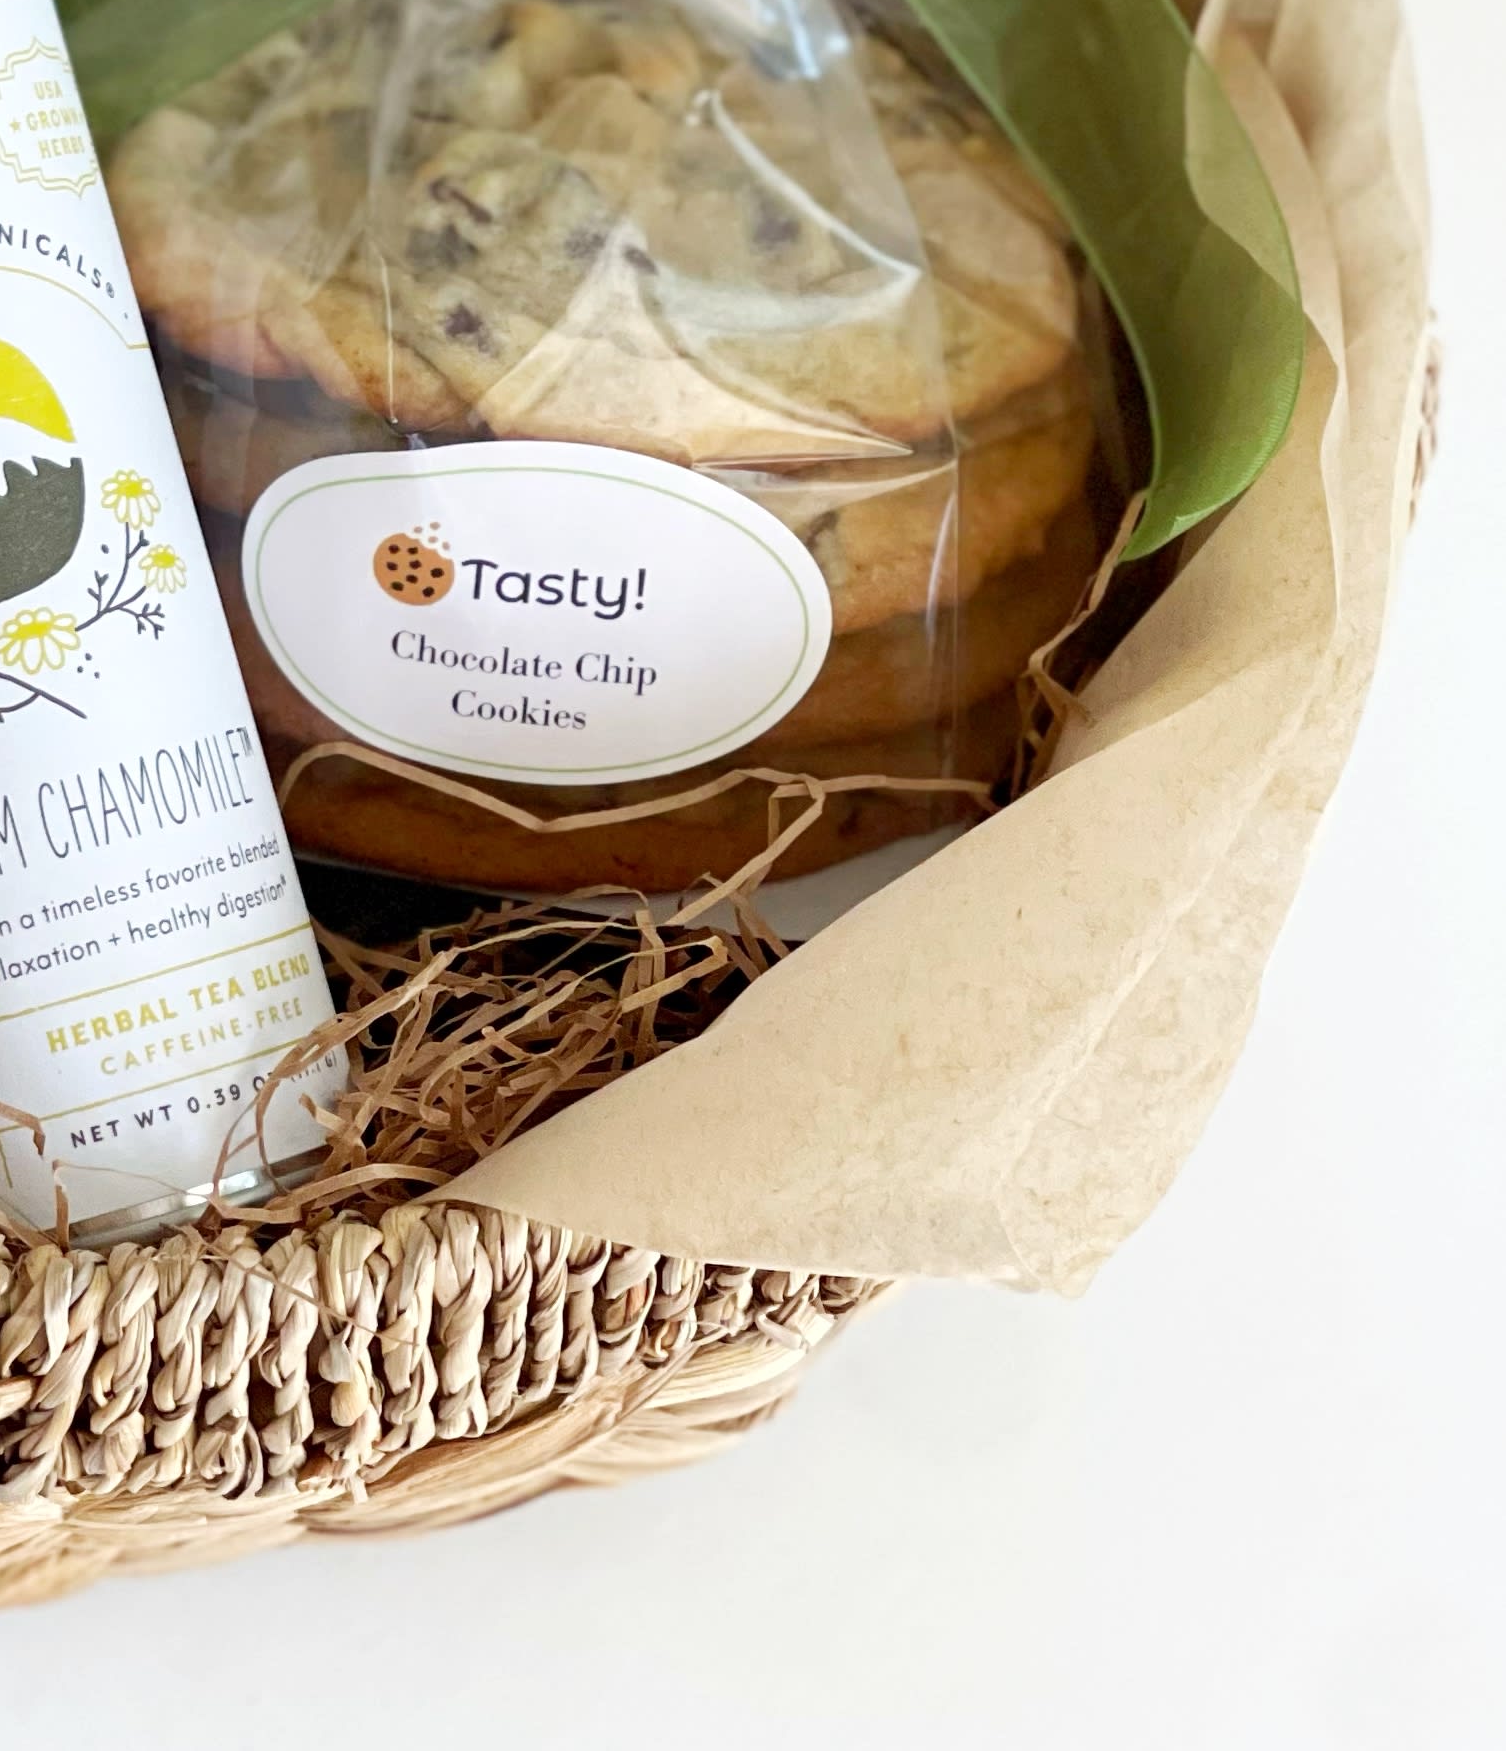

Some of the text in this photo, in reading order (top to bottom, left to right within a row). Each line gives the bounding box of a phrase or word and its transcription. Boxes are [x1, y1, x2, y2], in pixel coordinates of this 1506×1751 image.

[33, 79, 63, 101] USA
[461, 558, 647, 620] Tasty!
[390, 629, 658, 697] Chocolate Chip
[450, 689, 588, 731] Cookies
[19, 912, 36, 930] a
[41, 880, 142, 923] timeless
[145, 855, 227, 893] favorite
[227, 832, 281, 869] blended
[126, 902, 212, 944] healthy
[45, 952, 311, 1054] HERBAL TEA BLEND
[99, 996, 303, 1076] CAFFEINE-FREE
[69, 1118, 121, 1149] NET
[133, 1103, 173, 1130] WT
[185, 1082, 242, 1115] 0.39
